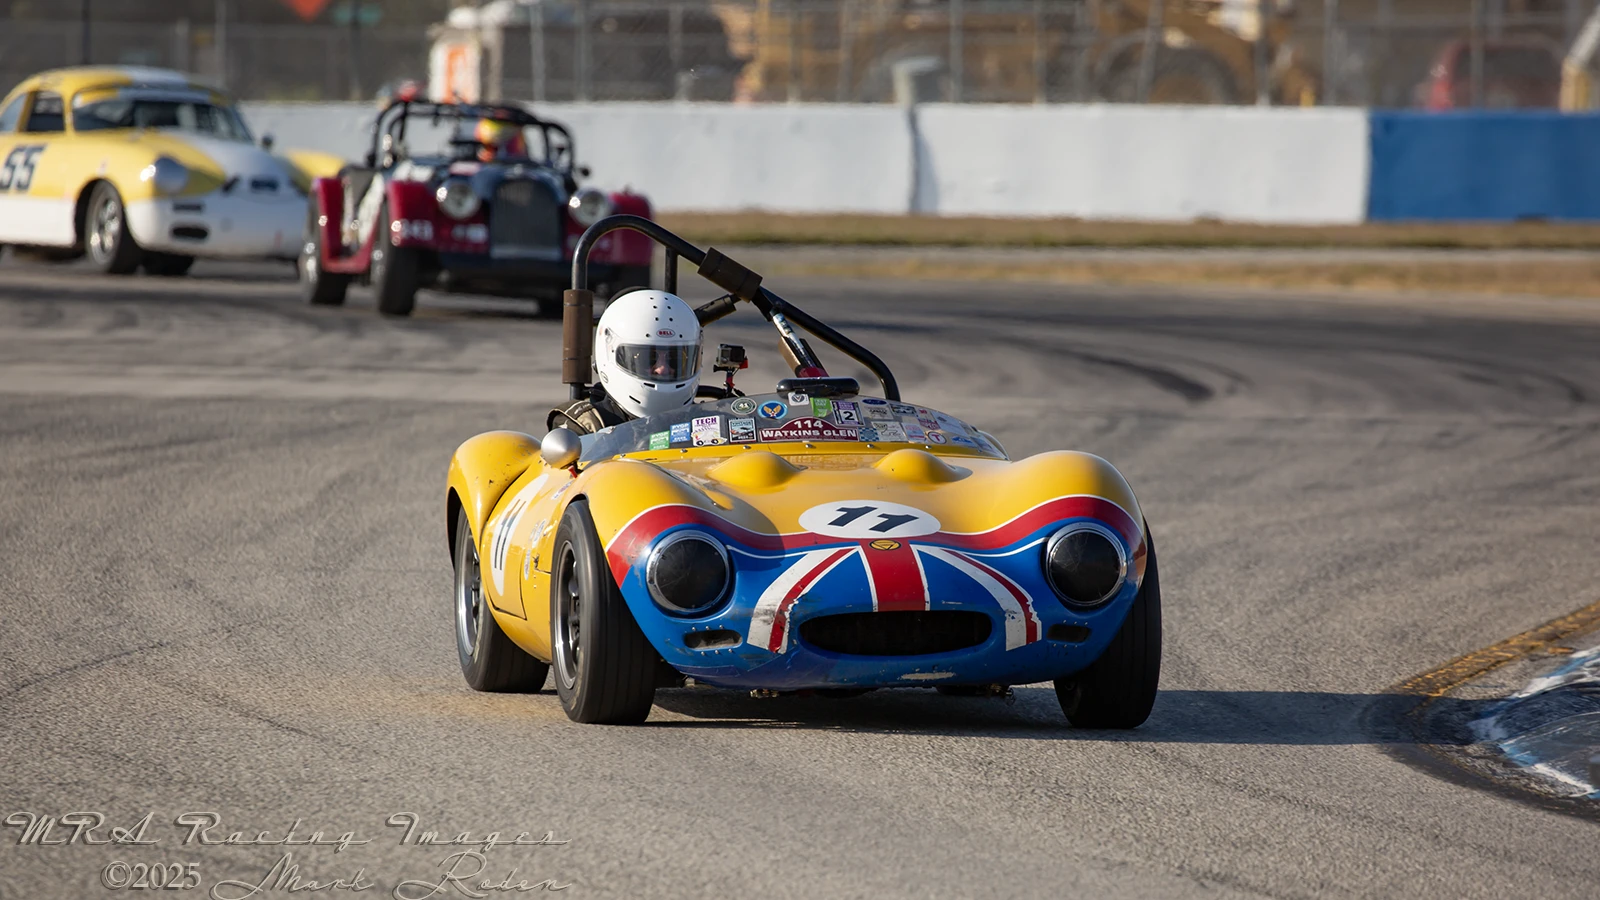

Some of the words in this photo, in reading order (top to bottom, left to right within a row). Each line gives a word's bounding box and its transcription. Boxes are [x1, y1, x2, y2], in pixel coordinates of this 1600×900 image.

[0, 146, 47, 191] 55
[843, 411, 855, 421] 2
[695, 417, 717, 425] TECH
[793, 420, 823, 428] 114
[762, 430, 820, 438] WATKINS
[823, 429, 857, 437] GLEN
[827, 506, 919, 533] 11
